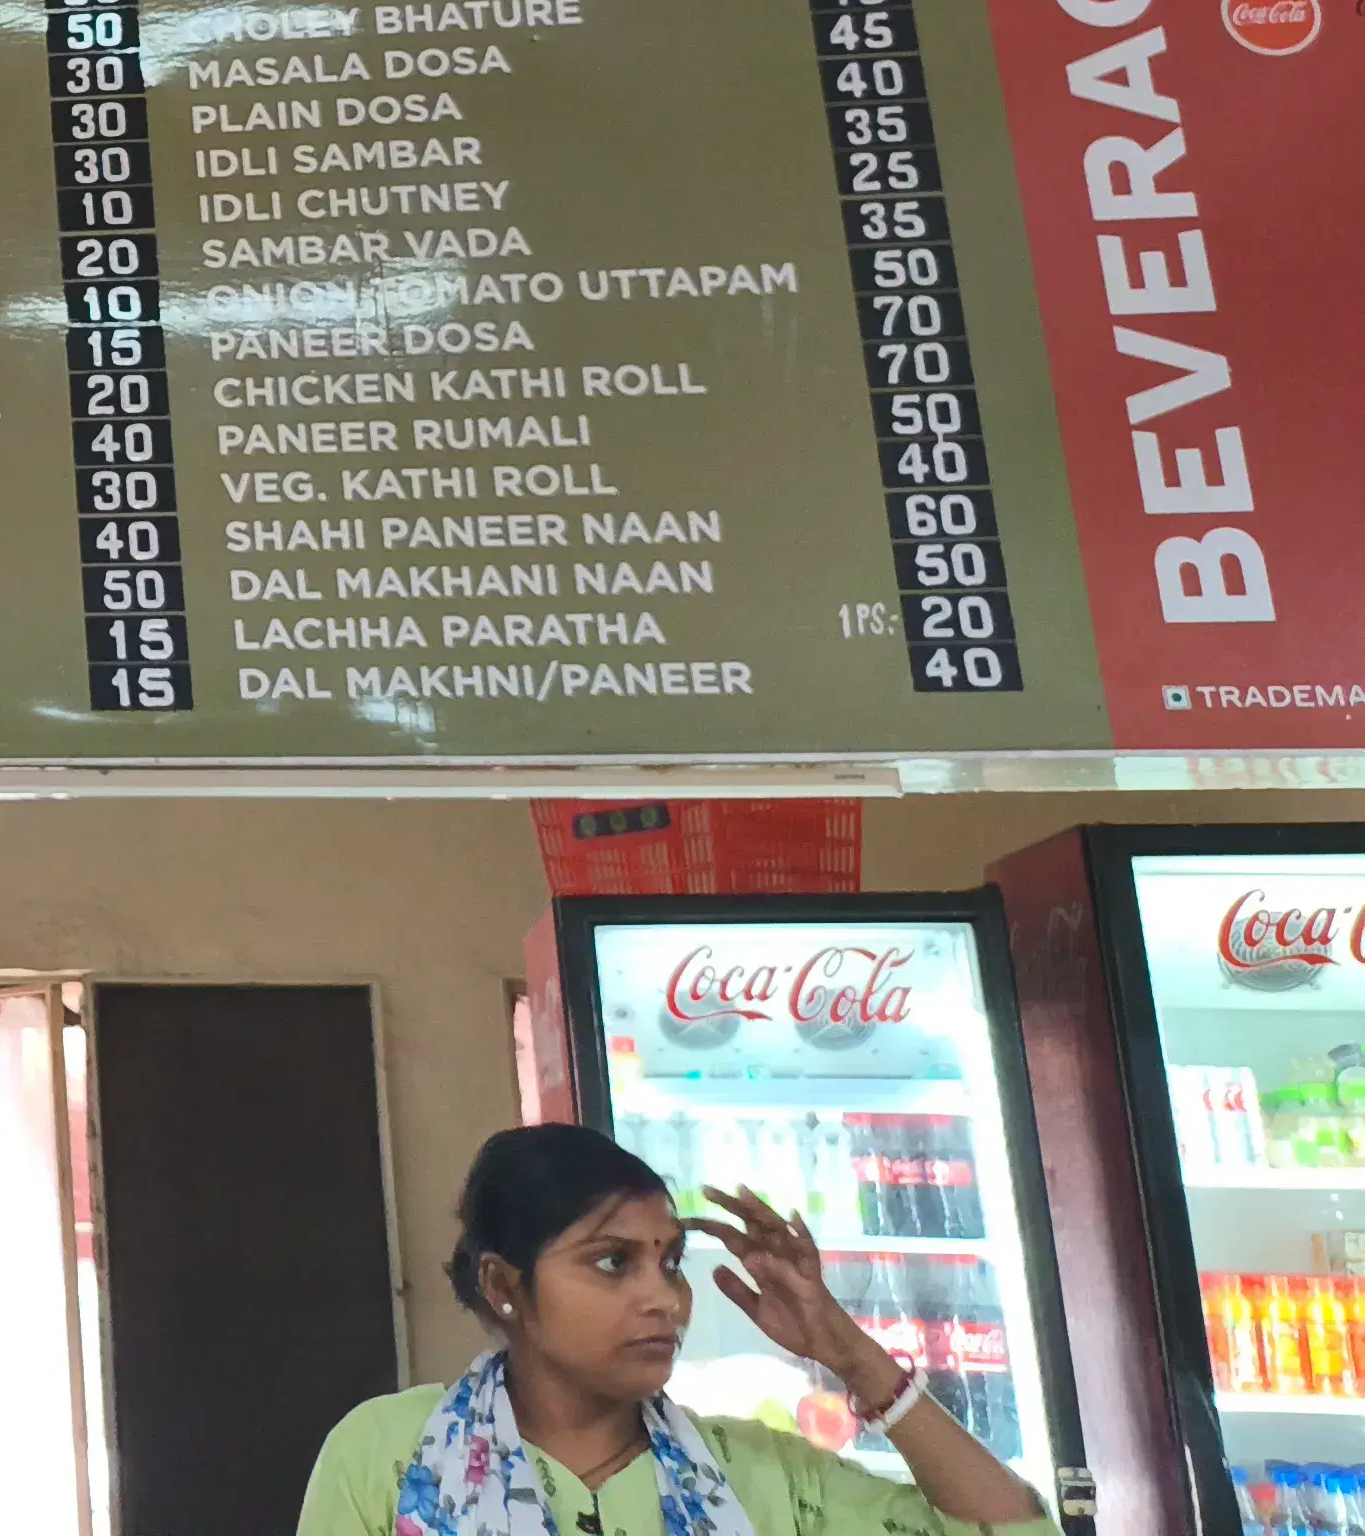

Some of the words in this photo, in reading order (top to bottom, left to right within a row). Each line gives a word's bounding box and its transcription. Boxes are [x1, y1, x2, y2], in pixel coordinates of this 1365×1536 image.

[188, 52, 371, 90] MASALA
[384, 46, 511, 79] DOSA
[837, 60, 903, 97] 40
[72, 102, 126, 138] 30
[195, 145, 278, 178] IDLI
[292, 138, 482, 173] SAMBAR
[850, 152, 918, 190] 25
[83, 191, 132, 225] 10
[198, 191, 282, 222] IDLI
[296, 182, 509, 219] CHUTNEY
[874, 249, 938, 286] 50
[88, 329, 141, 366] 15
[878, 343, 949, 381] 70
[212, 372, 415, 407] CHICKEN
[430, 368, 566, 401] KATHI
[580, 365, 708, 397] ROLL
[92, 423, 152, 462] 40
[216, 420, 398, 454] PANEER
[412, 416, 591, 450] RUMALI
[224, 517, 365, 550] SHAHI
[380, 514, 568, 548] PANEER
[581, 511, 722, 545] NAAN
[906, 495, 976, 533] 60
[96, 521, 159, 559] 40
[232, 616, 427, 649] LACHHA
[440, 615, 667, 647] PARATHA
[922, 597, 993, 636] 20
[110, 620, 173, 658] 15
[237, 666, 332, 698] DAL
[345, 663, 755, 697] MAKHNI/PANEER
[666, 944, 916, 1024] Coca-Cola
